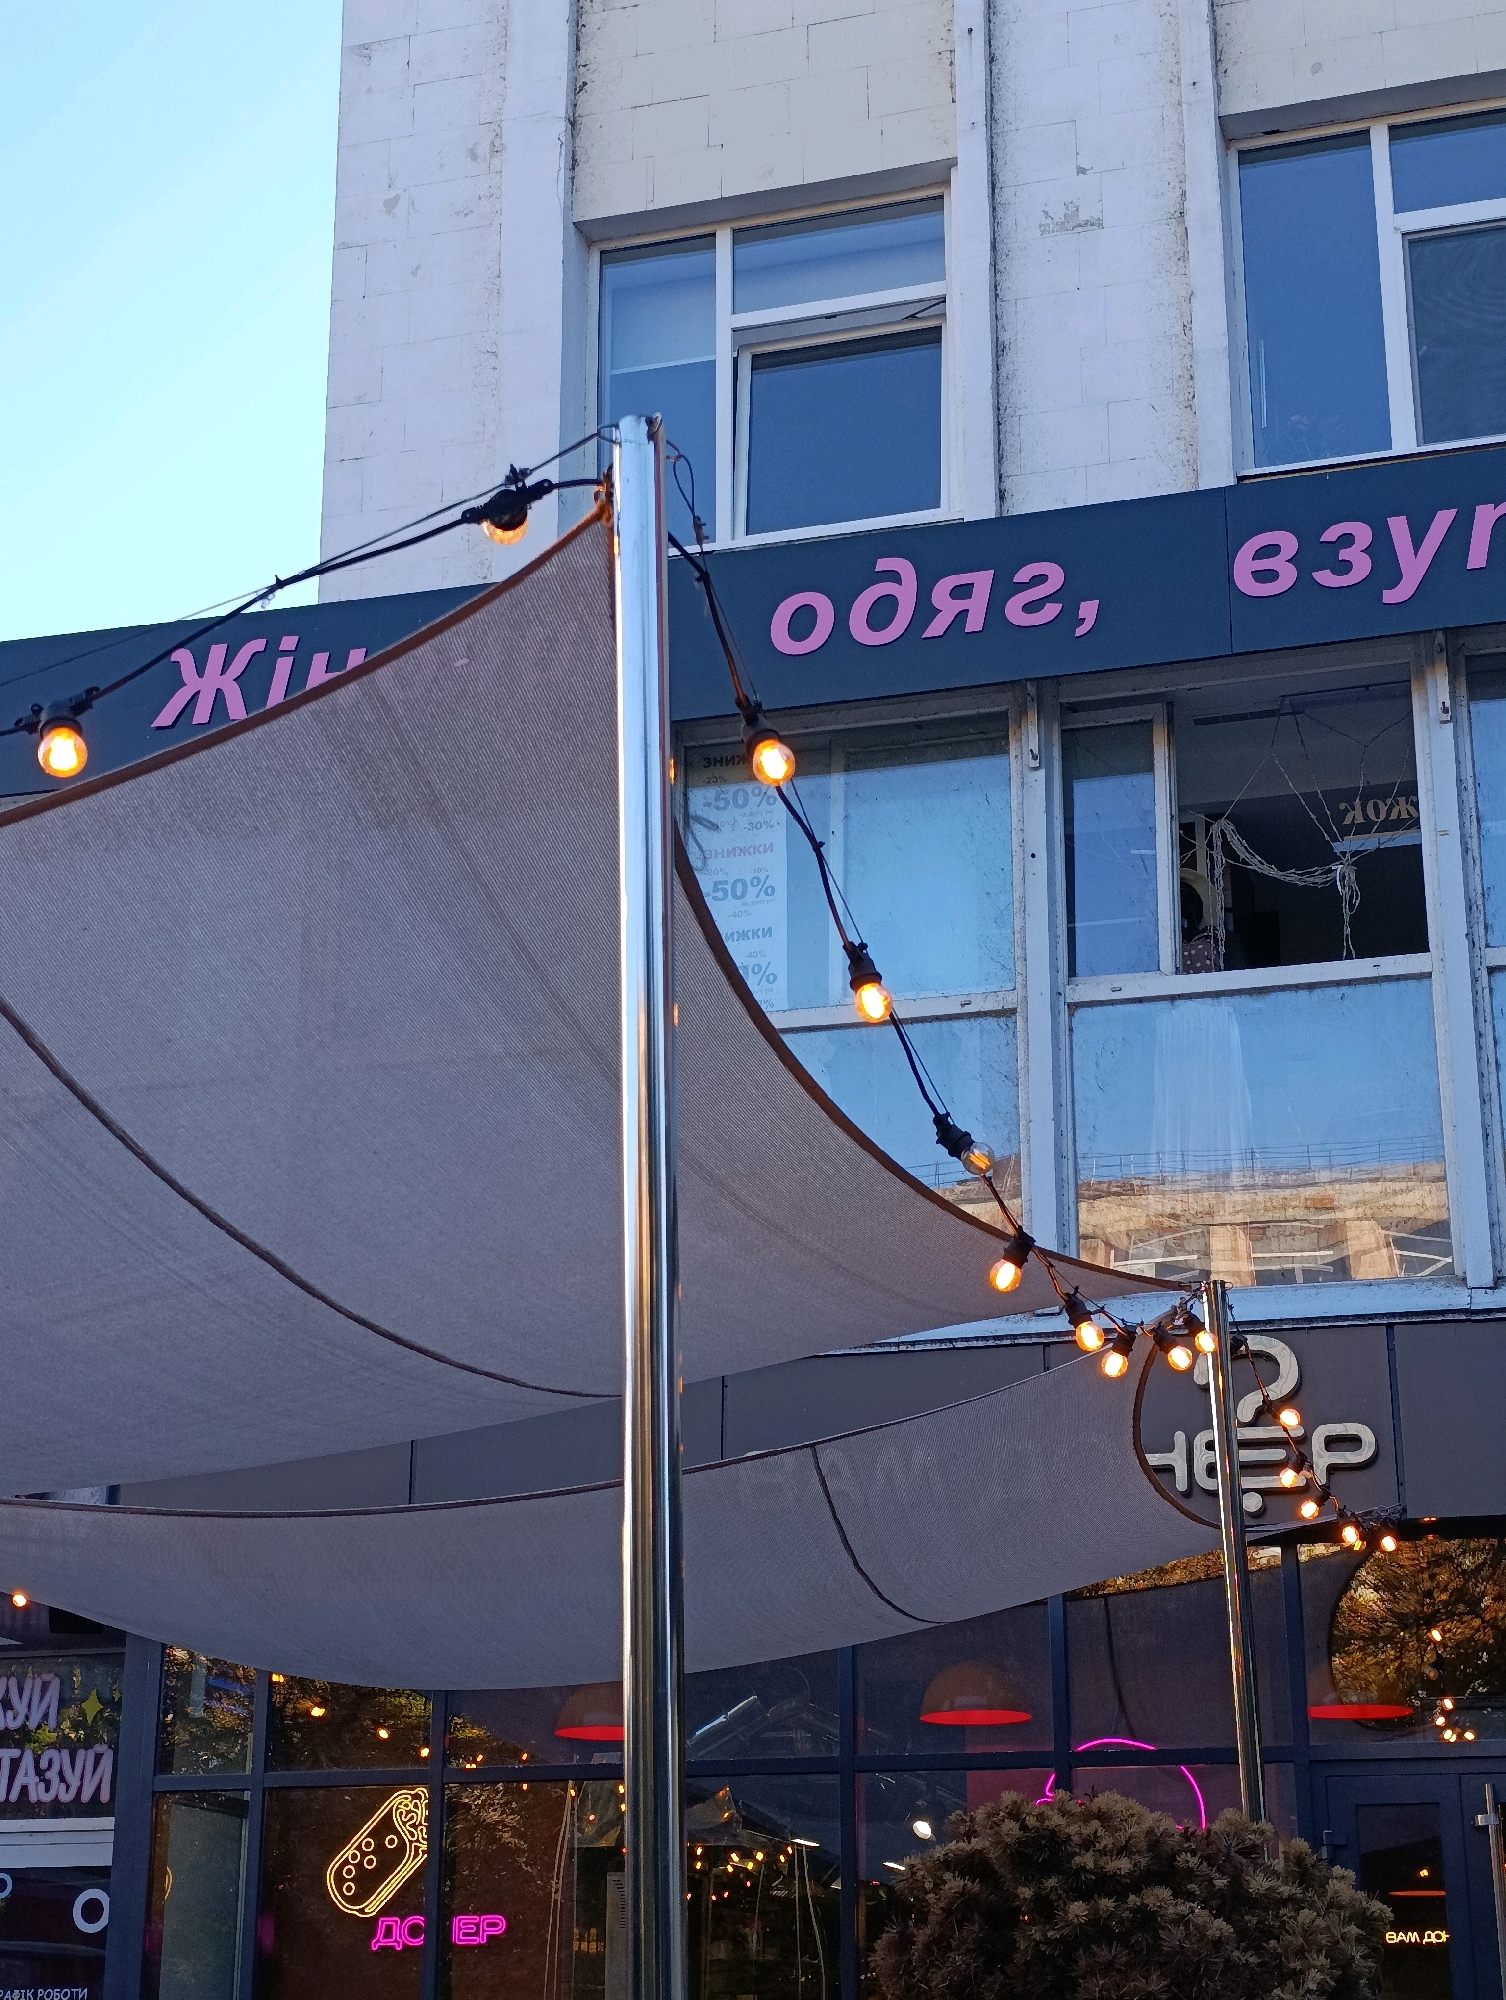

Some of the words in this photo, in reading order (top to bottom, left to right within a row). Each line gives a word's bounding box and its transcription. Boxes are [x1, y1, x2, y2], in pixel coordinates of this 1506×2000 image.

[771, 557, 1100, 657] одяг,
[703, 786, 778, 812] -50%
[743, 821, 775, 832] -30%
[704, 875, 776, 902] -50%
[722, 926, 773, 943] ИЖКИ
[371, 1915, 508, 1951] ДОЕР
[37, 1987, 88, 2000] РОБОТИ
